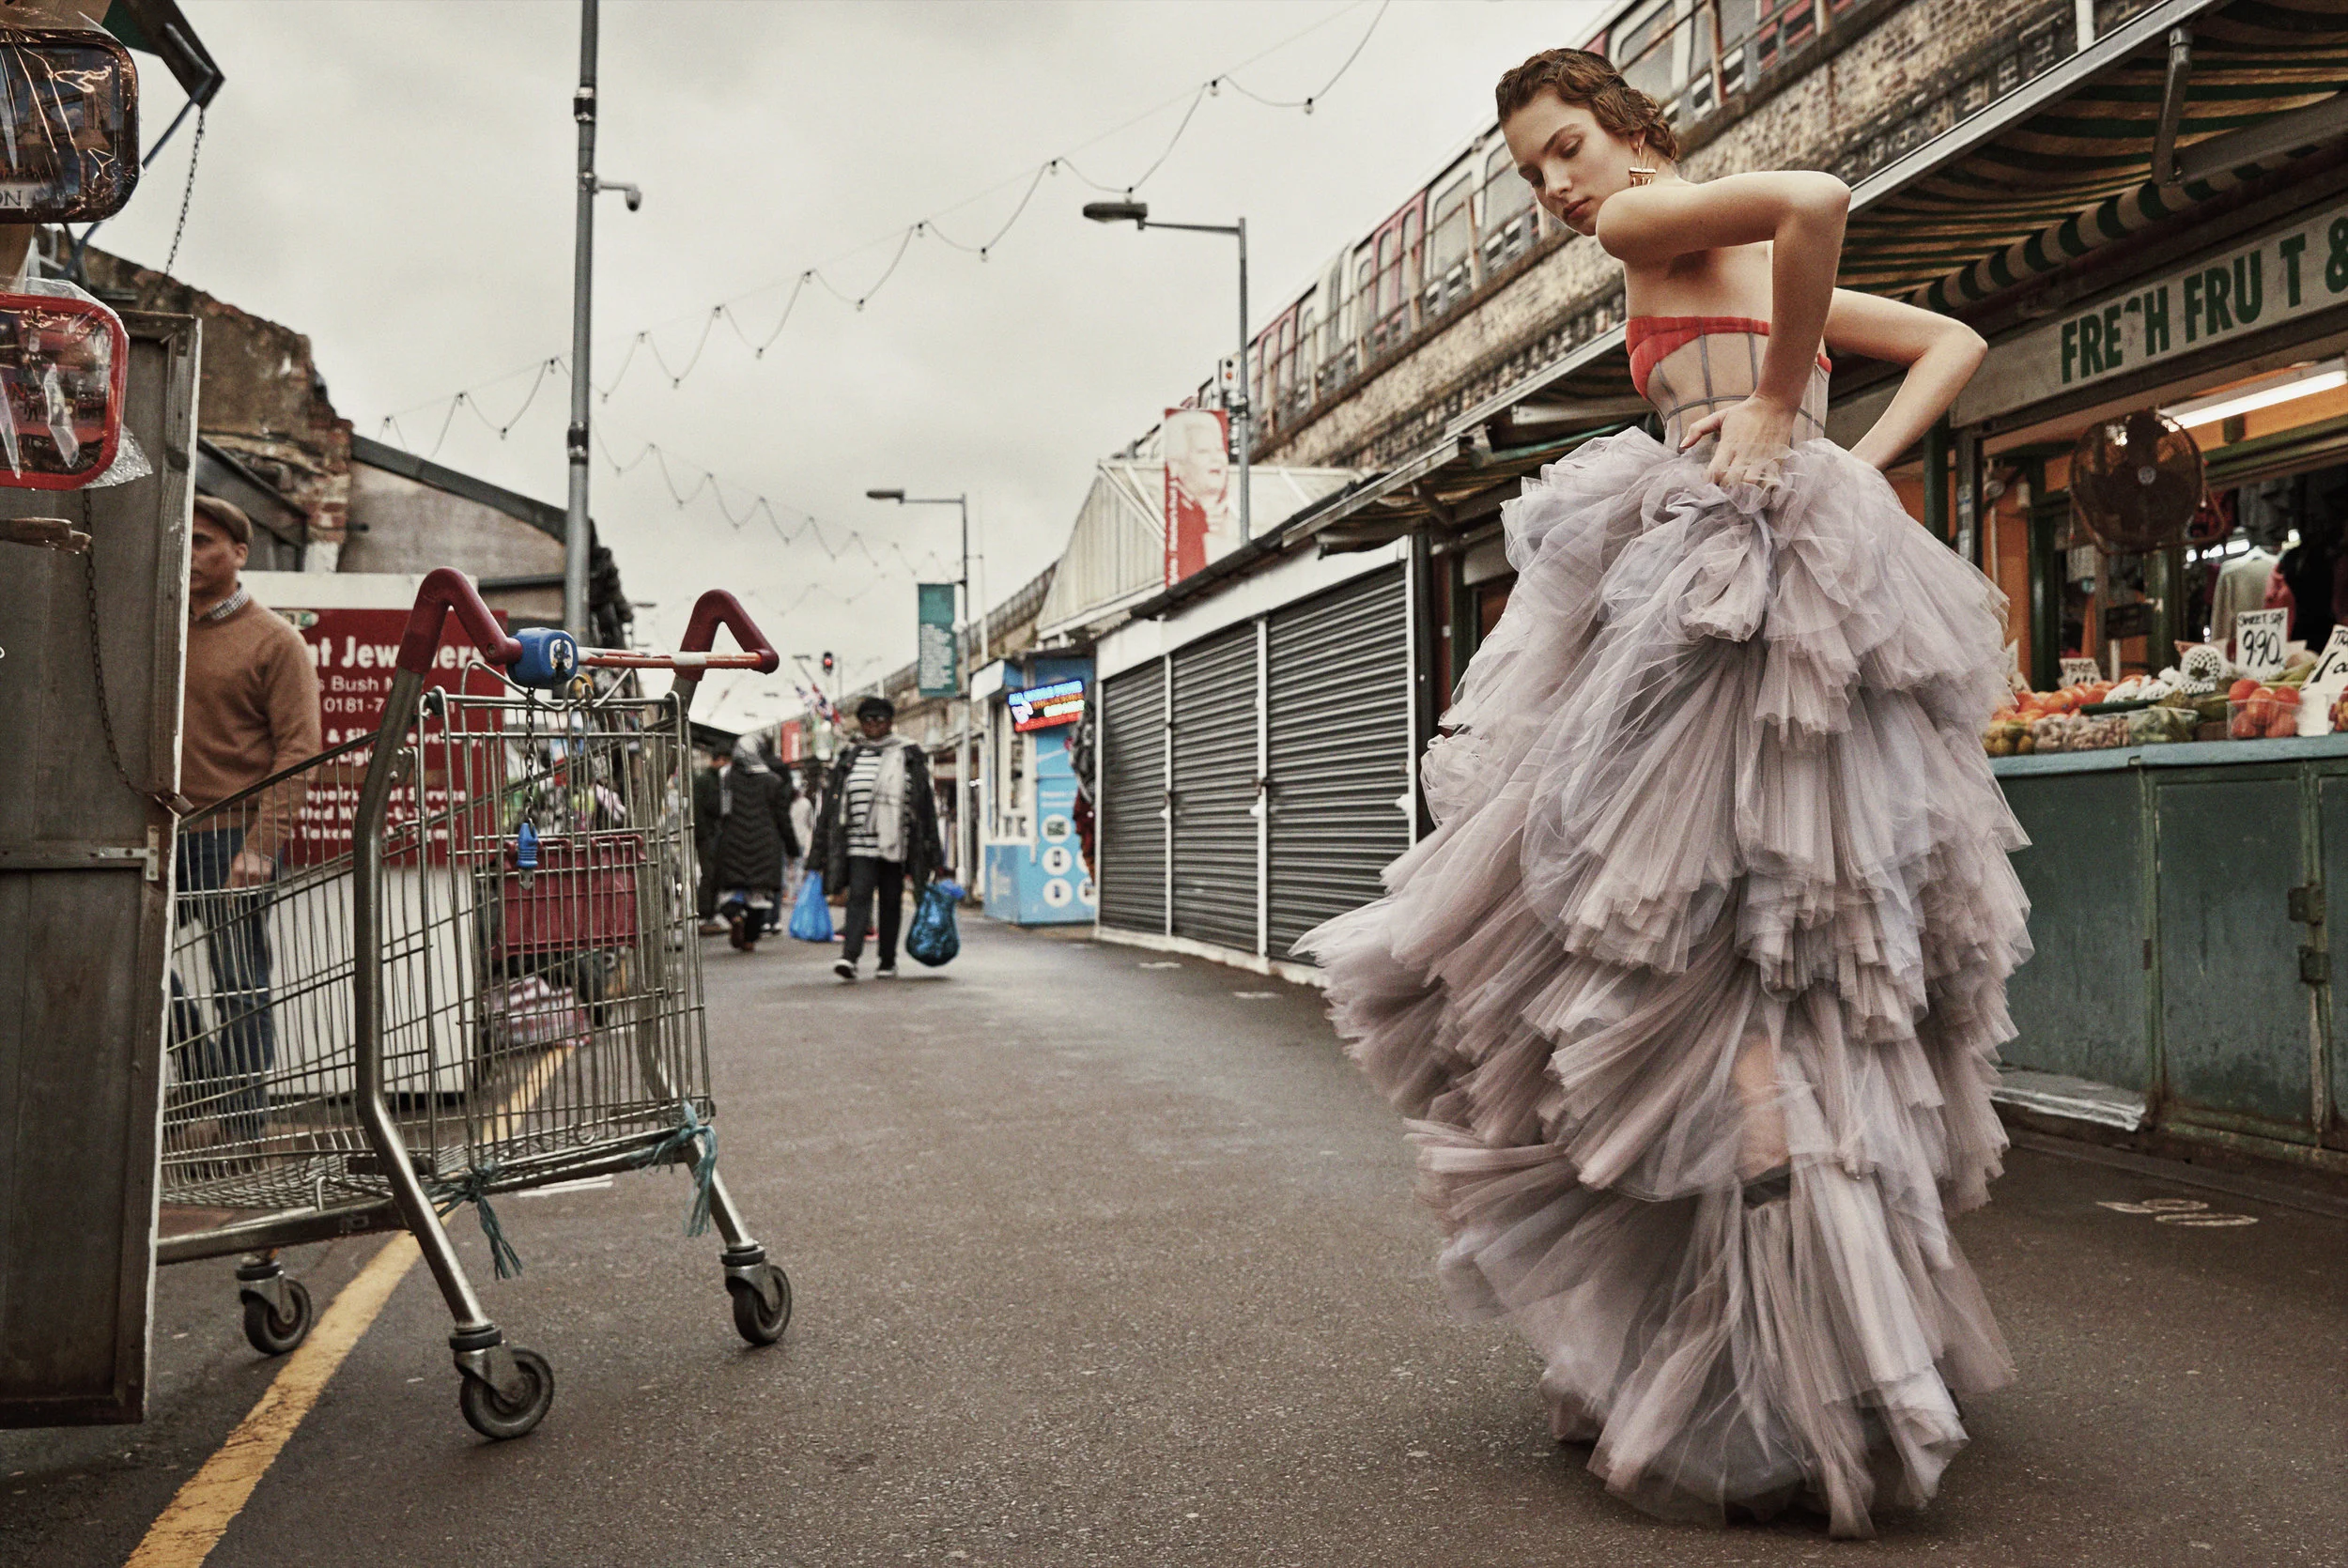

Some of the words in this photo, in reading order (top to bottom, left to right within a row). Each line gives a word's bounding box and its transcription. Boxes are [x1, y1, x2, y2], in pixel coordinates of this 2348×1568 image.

[2062, 286, 2170, 385] FREH
[2184, 233, 2306, 344] FRUT
[341, 635, 486, 669] Jewers
[331, 675, 379, 692] Bush
